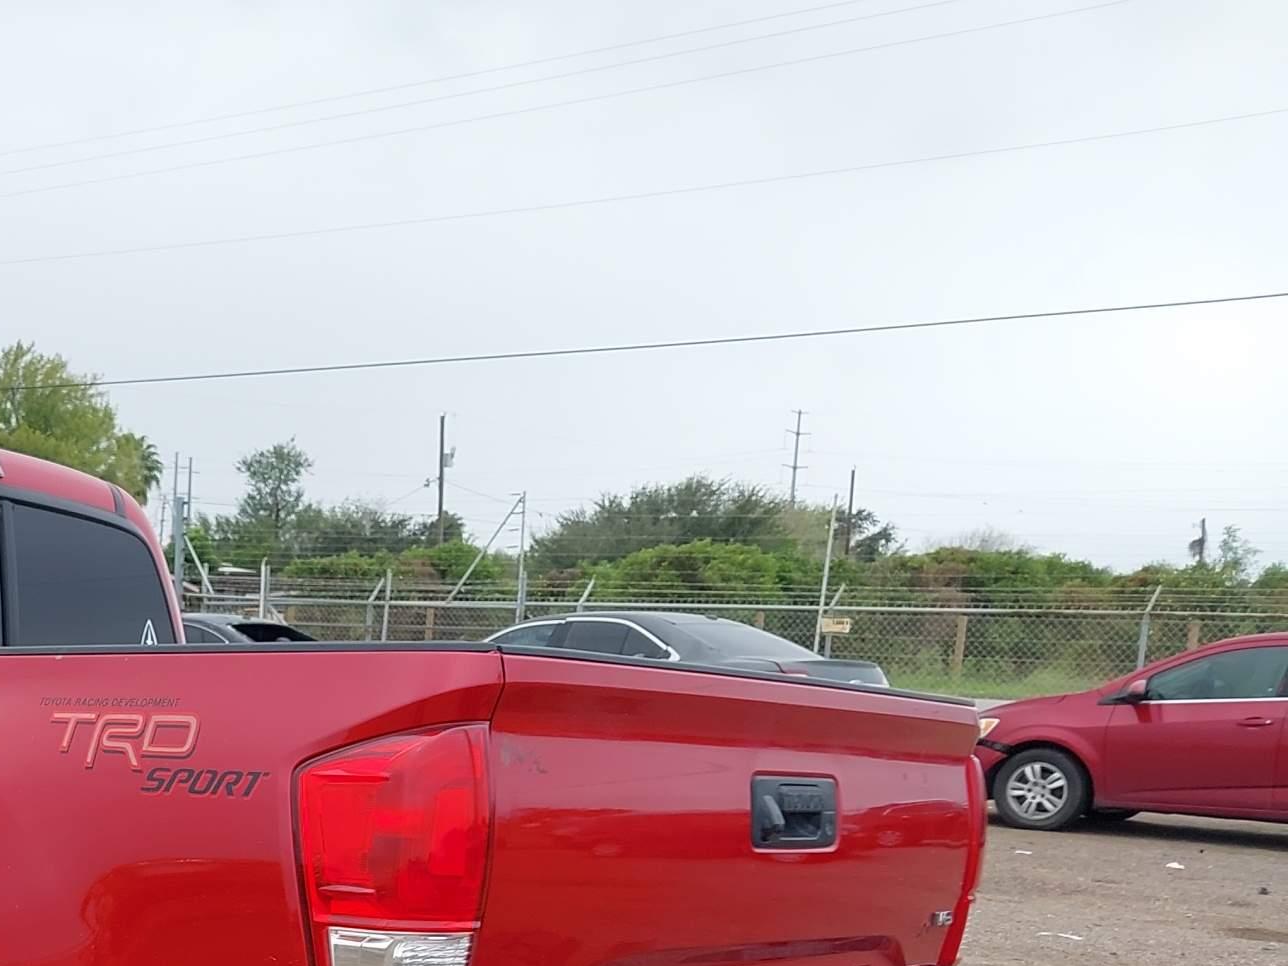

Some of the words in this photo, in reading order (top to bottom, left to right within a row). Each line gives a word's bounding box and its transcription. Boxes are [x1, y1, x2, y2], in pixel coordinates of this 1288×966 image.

[39, 697, 72, 706] TOYOTA
[73, 698, 109, 707] RACING
[110, 698, 181, 708] DEVELOPMENT
[50, 712, 200, 772] TRD
[140, 767, 271, 798] SPORT
